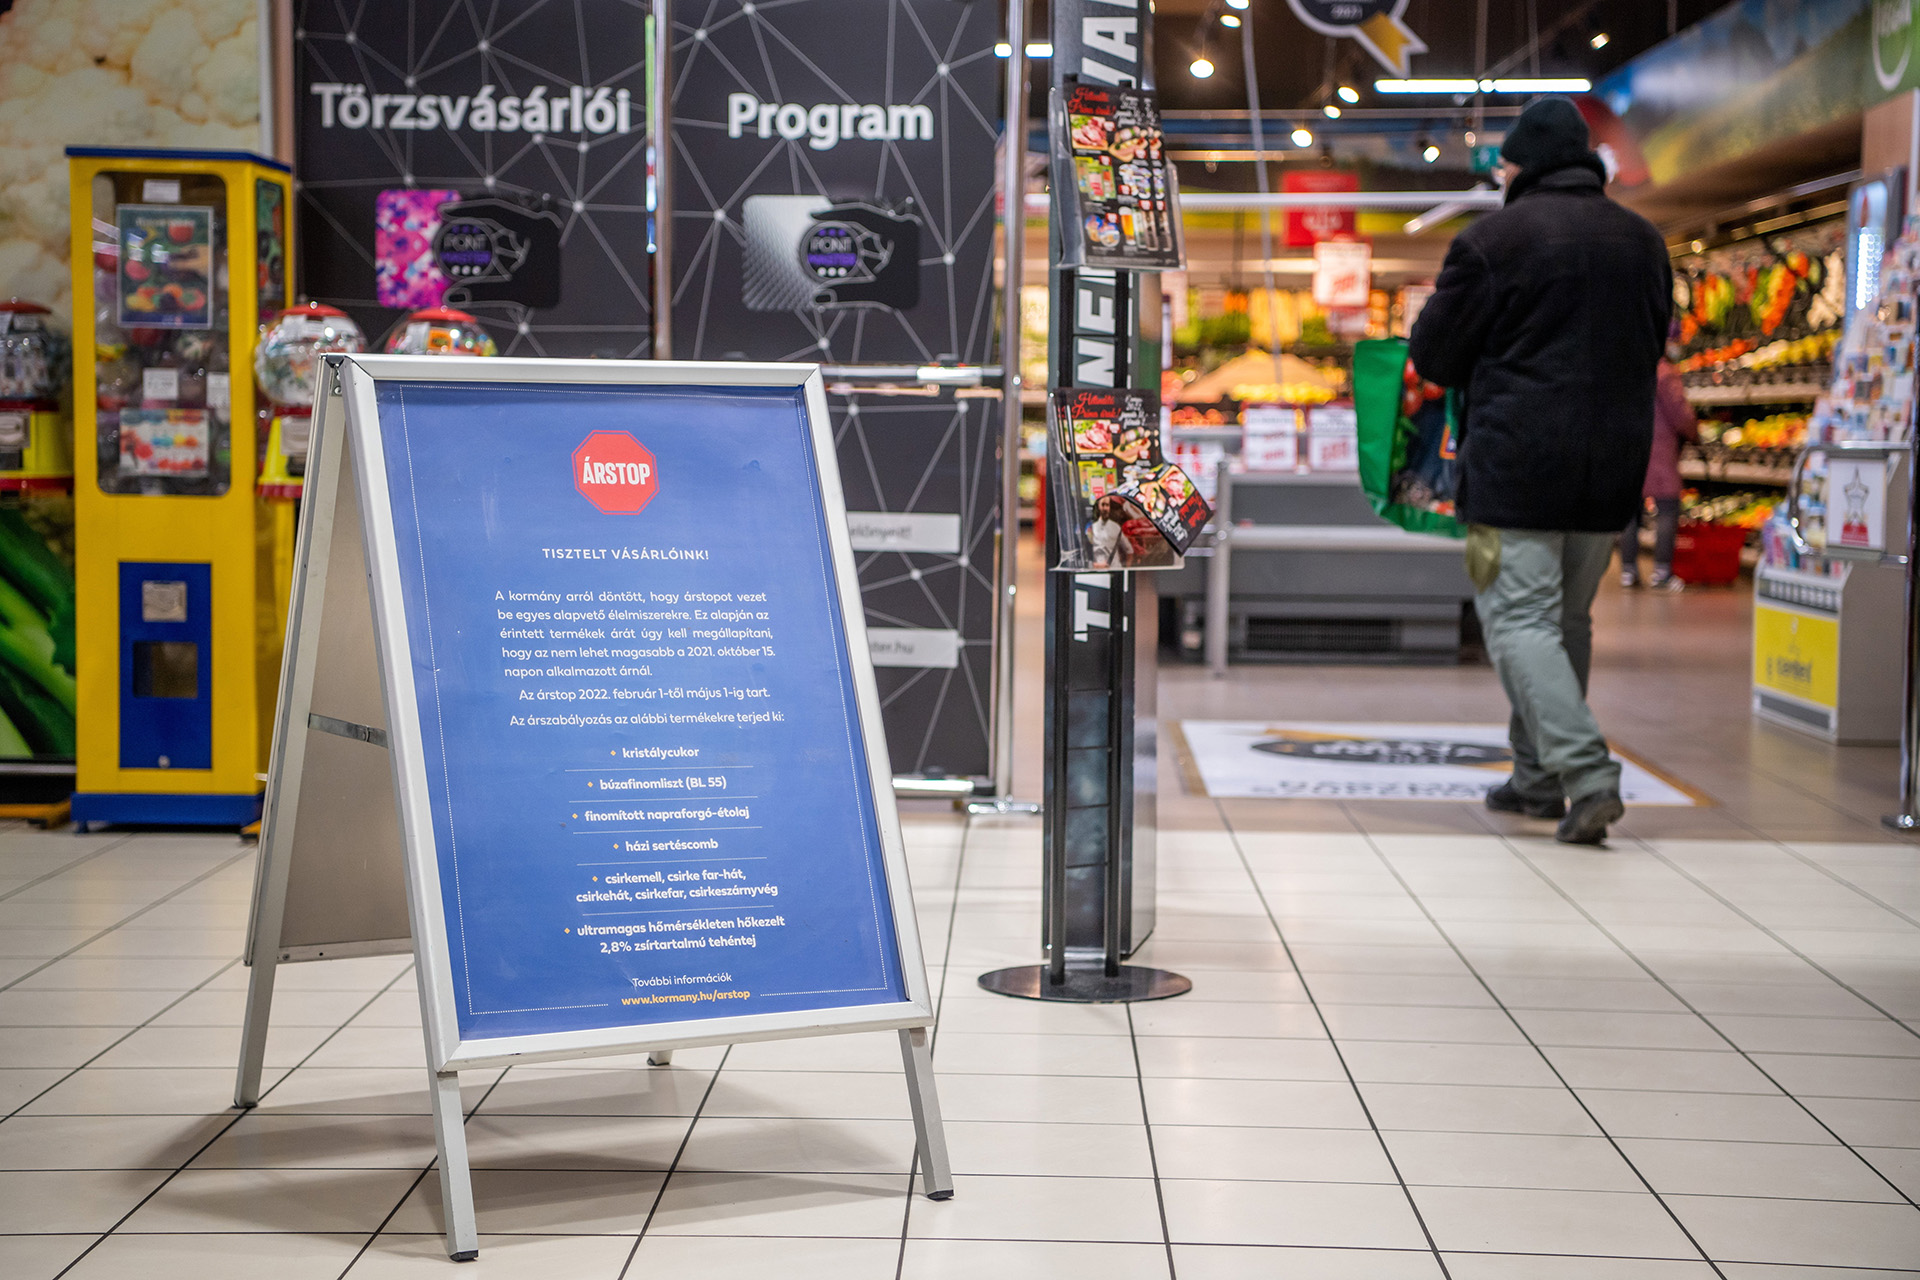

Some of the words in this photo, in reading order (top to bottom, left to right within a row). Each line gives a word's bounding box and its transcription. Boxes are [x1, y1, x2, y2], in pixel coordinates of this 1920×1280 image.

[310, 82, 632, 134] Törzsvásárlói
[727, 93, 935, 150] Program
[583, 456, 651, 485] ÁRSTOP
[542, 549, 607, 559] TISZTELT
[611, 547, 708, 560] VÁSÁRLÓINK!
[495, 591, 504, 600] A
[509, 591, 561, 604] kormány
[566, 591, 593, 601] arról
[599, 592, 645, 603] döntött,
[650, 592, 679, 604] hogy
[684, 591, 733, 603] árstopot
[737, 593, 767, 601] vezet
[498, 609, 513, 619] be
[516, 612, 551, 622] egyes
[554, 610, 605, 622] alapvető
[608, 610, 691, 620] élelmiszerekre.
[695, 610, 708, 619] Ez
[711, 610, 753, 622] alapján
[500, 628, 544, 638] érintett
[550, 628, 605, 638] termékek
[611, 628, 636, 638] árát
[641, 628, 662, 641] úgy
[668, 628, 687, 638] kell
[693, 628, 773, 640] megállapítani,
[502, 647, 532, 660] hogy
[580, 647, 609, 657] lehet
[611, 647, 674, 659] magasabb
[687, 647, 715, 656] 2021.
[717, 646, 760, 656] október
[762, 646, 775, 656] 15.
[505, 669, 543, 679] napon
[546, 666, 617, 676] alkalmazott
[620, 665, 652, 676] árnál.
[519, 690, 534, 700] Az
[537, 689, 576, 702] árstop
[578, 689, 610, 699] 2022.
[613, 688, 656, 699] február
[658, 688, 684, 698] 1-től
[687, 687, 721, 700] május
[723, 687, 744, 700] 1-ig
[746, 688, 770, 697] tart.
[510, 716, 525, 725] Az
[527, 714, 612, 727] árszabályozás
[630, 713, 667, 724] alábbi
[669, 712, 734, 723] termékekre
[736, 712, 770, 724] terjed
[772, 711, 784, 721] ki:
[623, 747, 699, 760] kristálycukor
[600, 778, 684, 789] búzafinomliszt
[686, 777, 706, 790] (BL
[708, 776, 726, 789] 55)
[585, 810, 645, 821] finomított
[647, 806, 749, 821] napraforgó-étolaj
[626, 840, 650, 851] házi
[652, 838, 718, 850] sertéscomb
[605, 872, 665, 884] csirkemell,
[667, 870, 700, 881] csirke
[702, 868, 746, 880] far-hát,
[576, 890, 632, 902] csirkehát,
[635, 888, 686, 899] csirkefar,
[689, 884, 778, 897] csirkeszárnyvég
[577, 925, 646, 936] ultramagas
[648, 919, 735, 932] hőmérsékleten
[737, 916, 785, 928] hőkezelt
[600, 941, 632, 954] 2,8%
[634, 937, 706, 951] zsírtartalmú
[708, 934, 756, 947] tehéntej
[632, 976, 672, 989] További
[674, 973, 732, 984] információk
[621, 990, 750, 1005] www.kormany.hu/arstop
